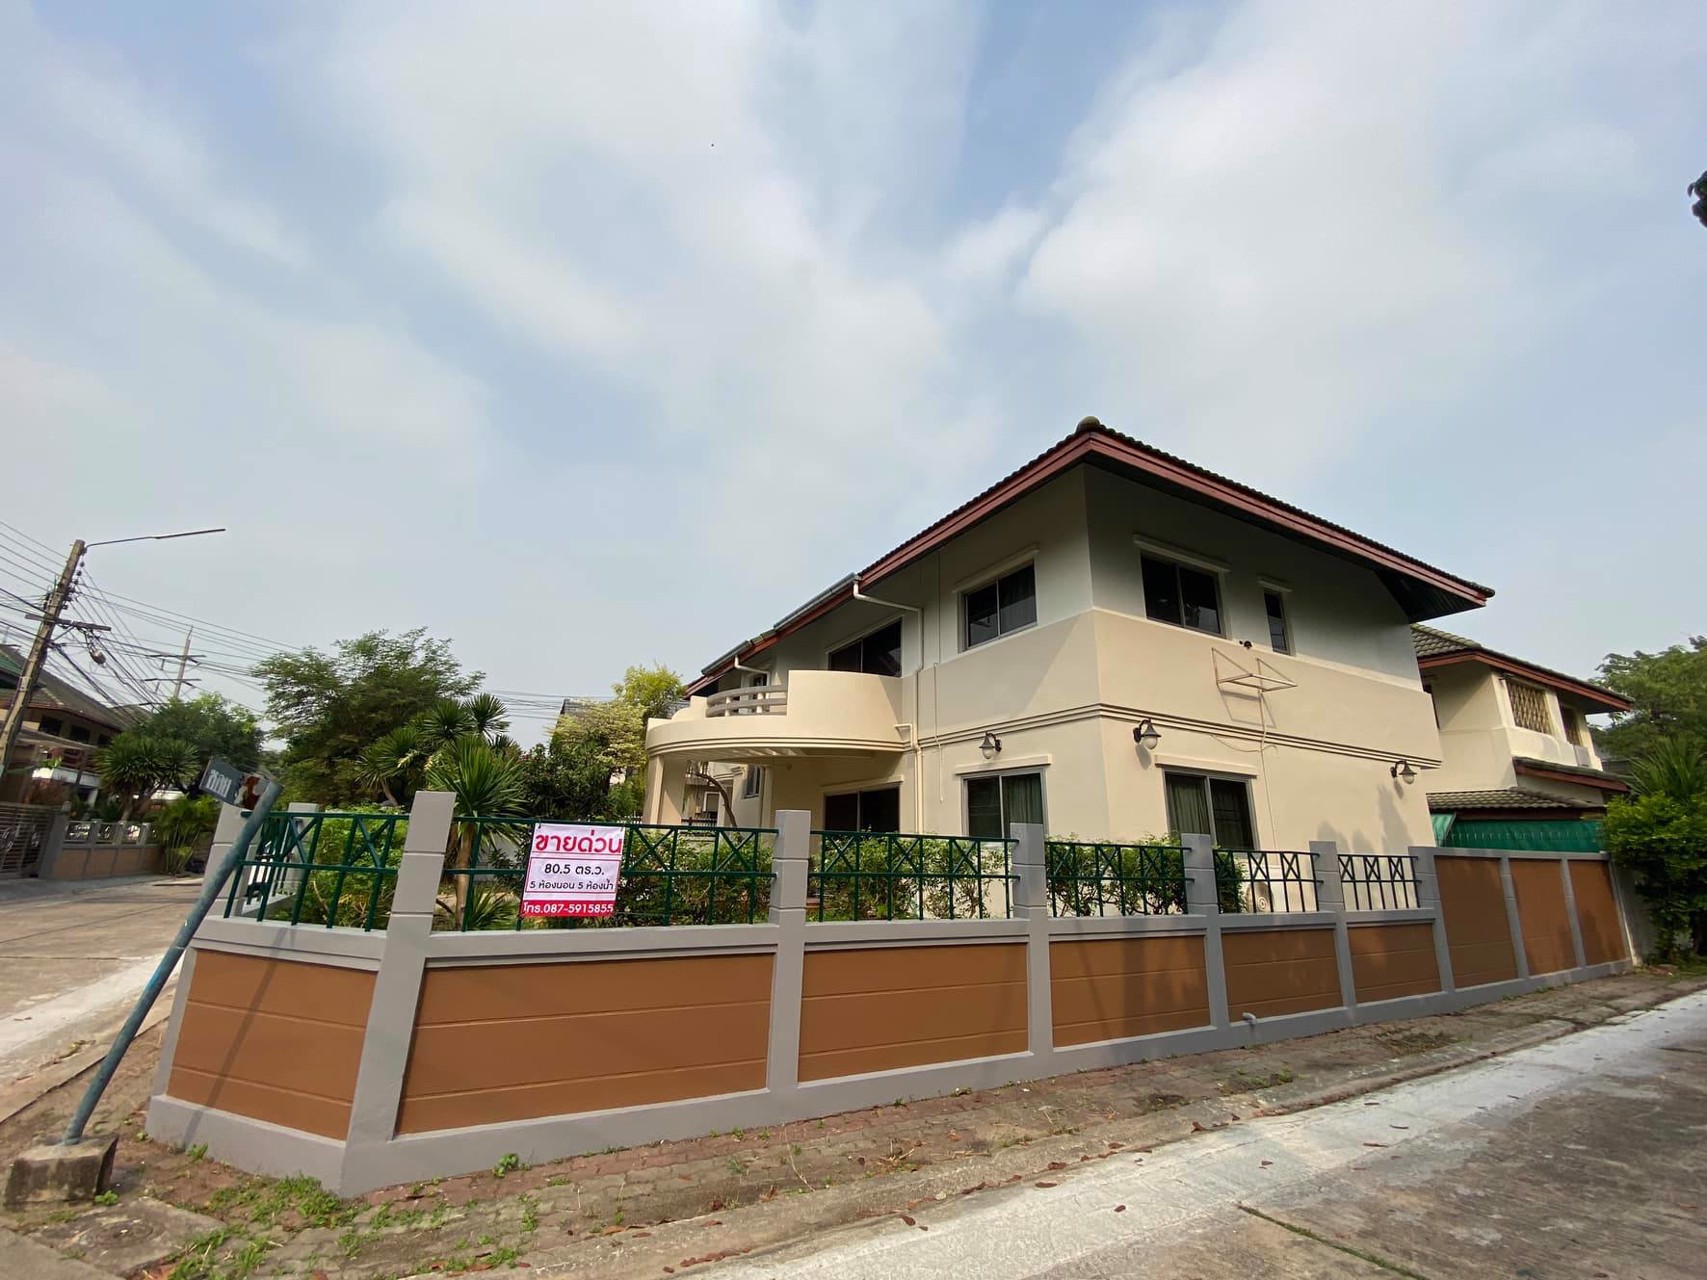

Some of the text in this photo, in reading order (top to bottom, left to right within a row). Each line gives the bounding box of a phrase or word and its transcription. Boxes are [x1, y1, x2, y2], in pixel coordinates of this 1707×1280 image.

[535, 829, 622, 853] ขายด่วน
[544, 864, 605, 875] 80.5 ตร.ว.
[538, 879, 575, 889] ห้องนอน
[586, 879, 614, 890] ห้องน้ำ
